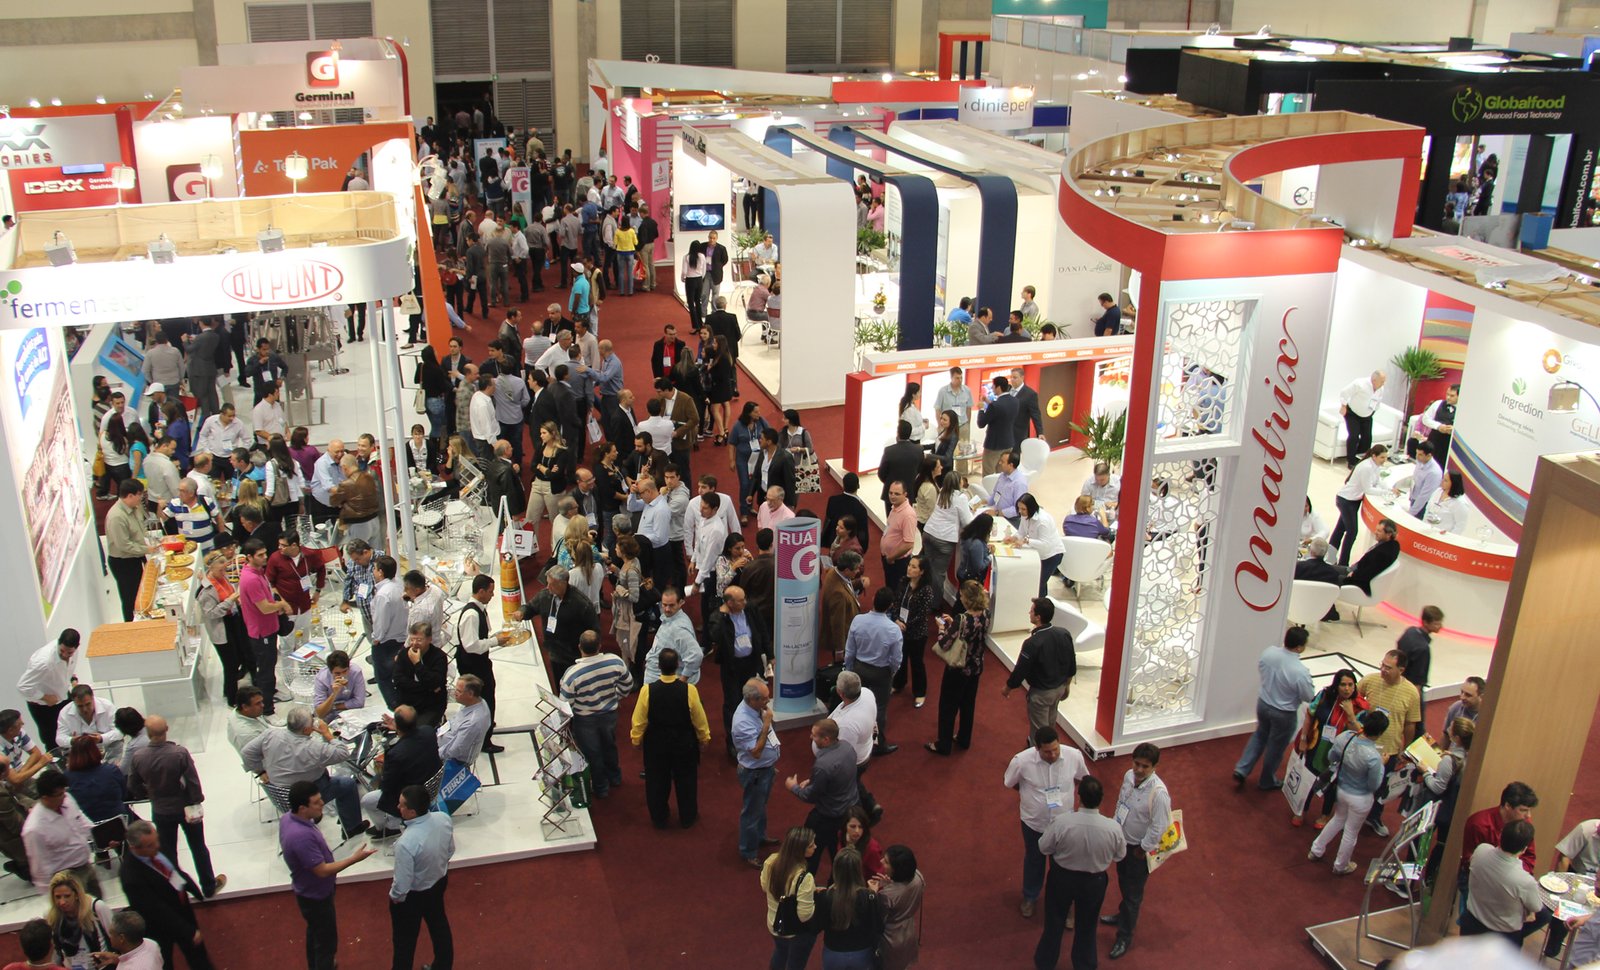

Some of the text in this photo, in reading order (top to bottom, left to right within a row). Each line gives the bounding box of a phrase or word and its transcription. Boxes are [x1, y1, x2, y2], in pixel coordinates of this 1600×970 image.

[295, 91, 354, 102] Germinal
[1484, 95, 1566, 110] Globalfood
[1482, 110, 1562, 120] Advanced Food Technology
[311, 157, 338, 170] Pak
[23, 178, 86, 196] IDEXX
[1501, 392, 1544, 419] Ingredion
[1234, 306, 1299, 612] matrix
[779, 531, 813, 546] RUA
[1412, 540, 1459, 562] DEGUSTAÇÕES
[791, 544, 820, 582] G
